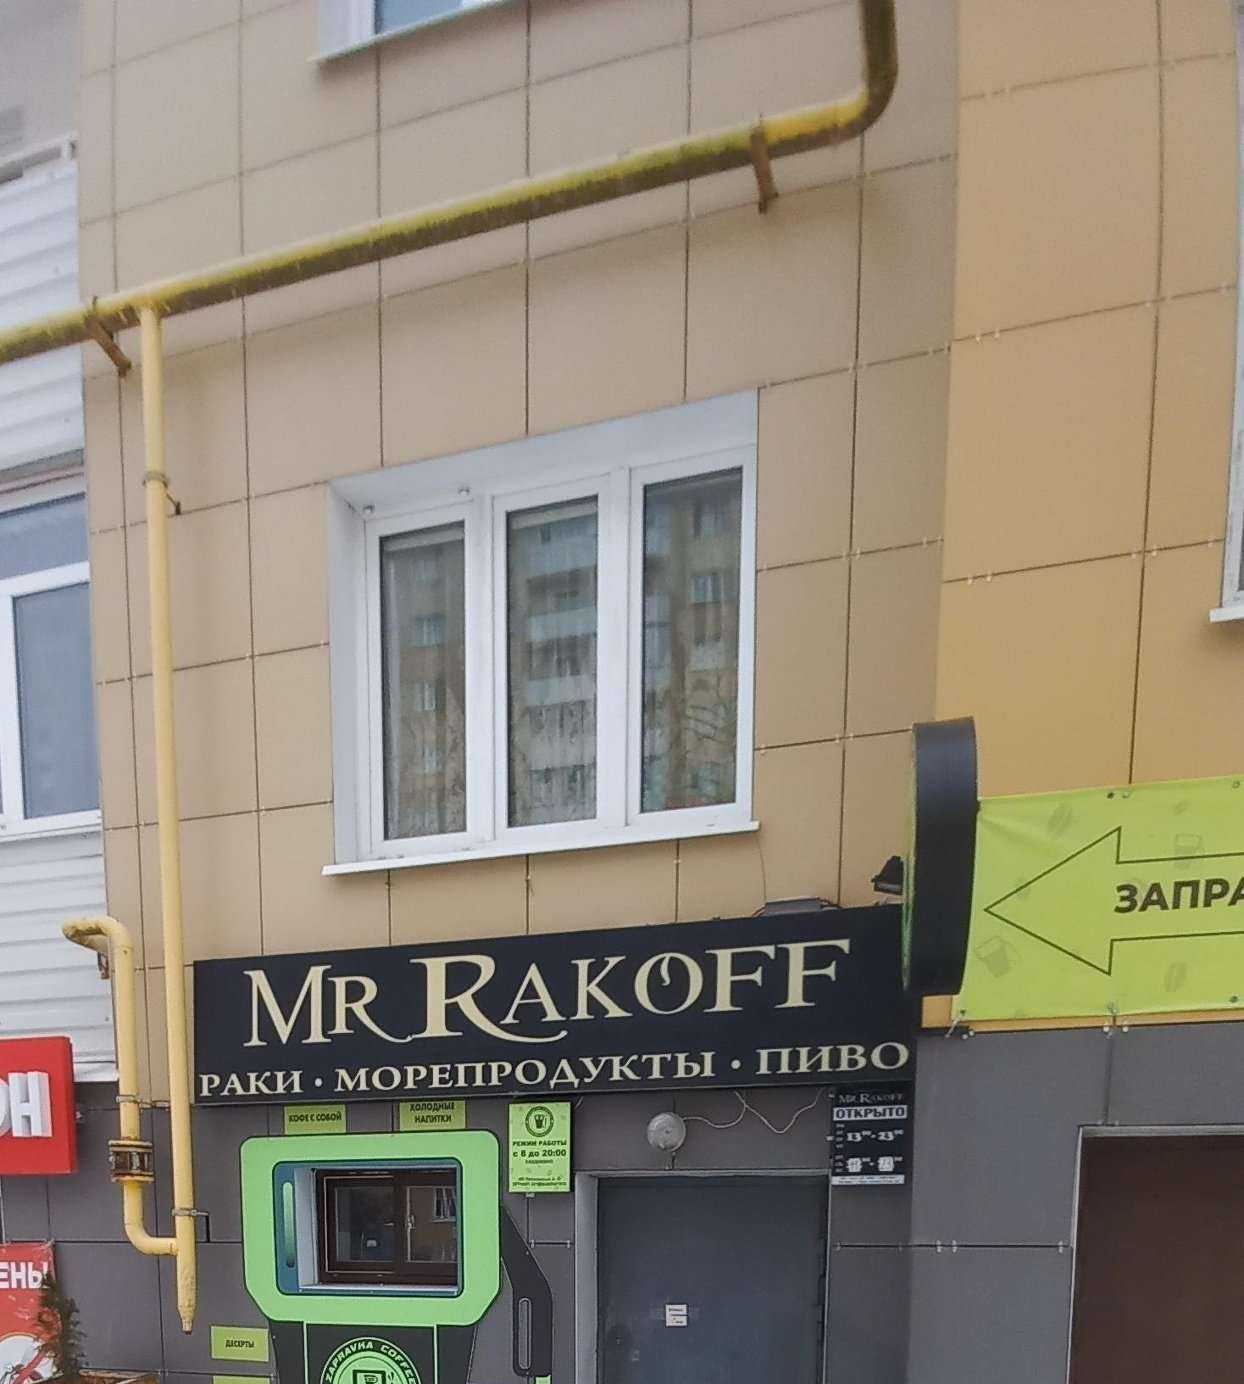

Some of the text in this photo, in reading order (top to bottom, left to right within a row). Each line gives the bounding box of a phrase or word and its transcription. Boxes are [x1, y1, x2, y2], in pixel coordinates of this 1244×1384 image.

[243, 938, 852, 1047] MR RAKOFF
[200, 1041, 910, 1098] РАКИ МОРЕПРОДУКТЫ ПИВО
[410, 1102, 455, 1112] ХОЛОДНЫЕ
[288, 1113, 310, 1123] КОФЕ
[316, 1111, 342, 1122] СОБОЙ
[836, 1107, 905, 1119] ОТКРЫТО
[414, 1115, 452, 1124] НАПИТКИ
[542, 1149, 567, 1157] 20:00
[225, 1339, 255, 1348] ДЕСЕРТЫ
